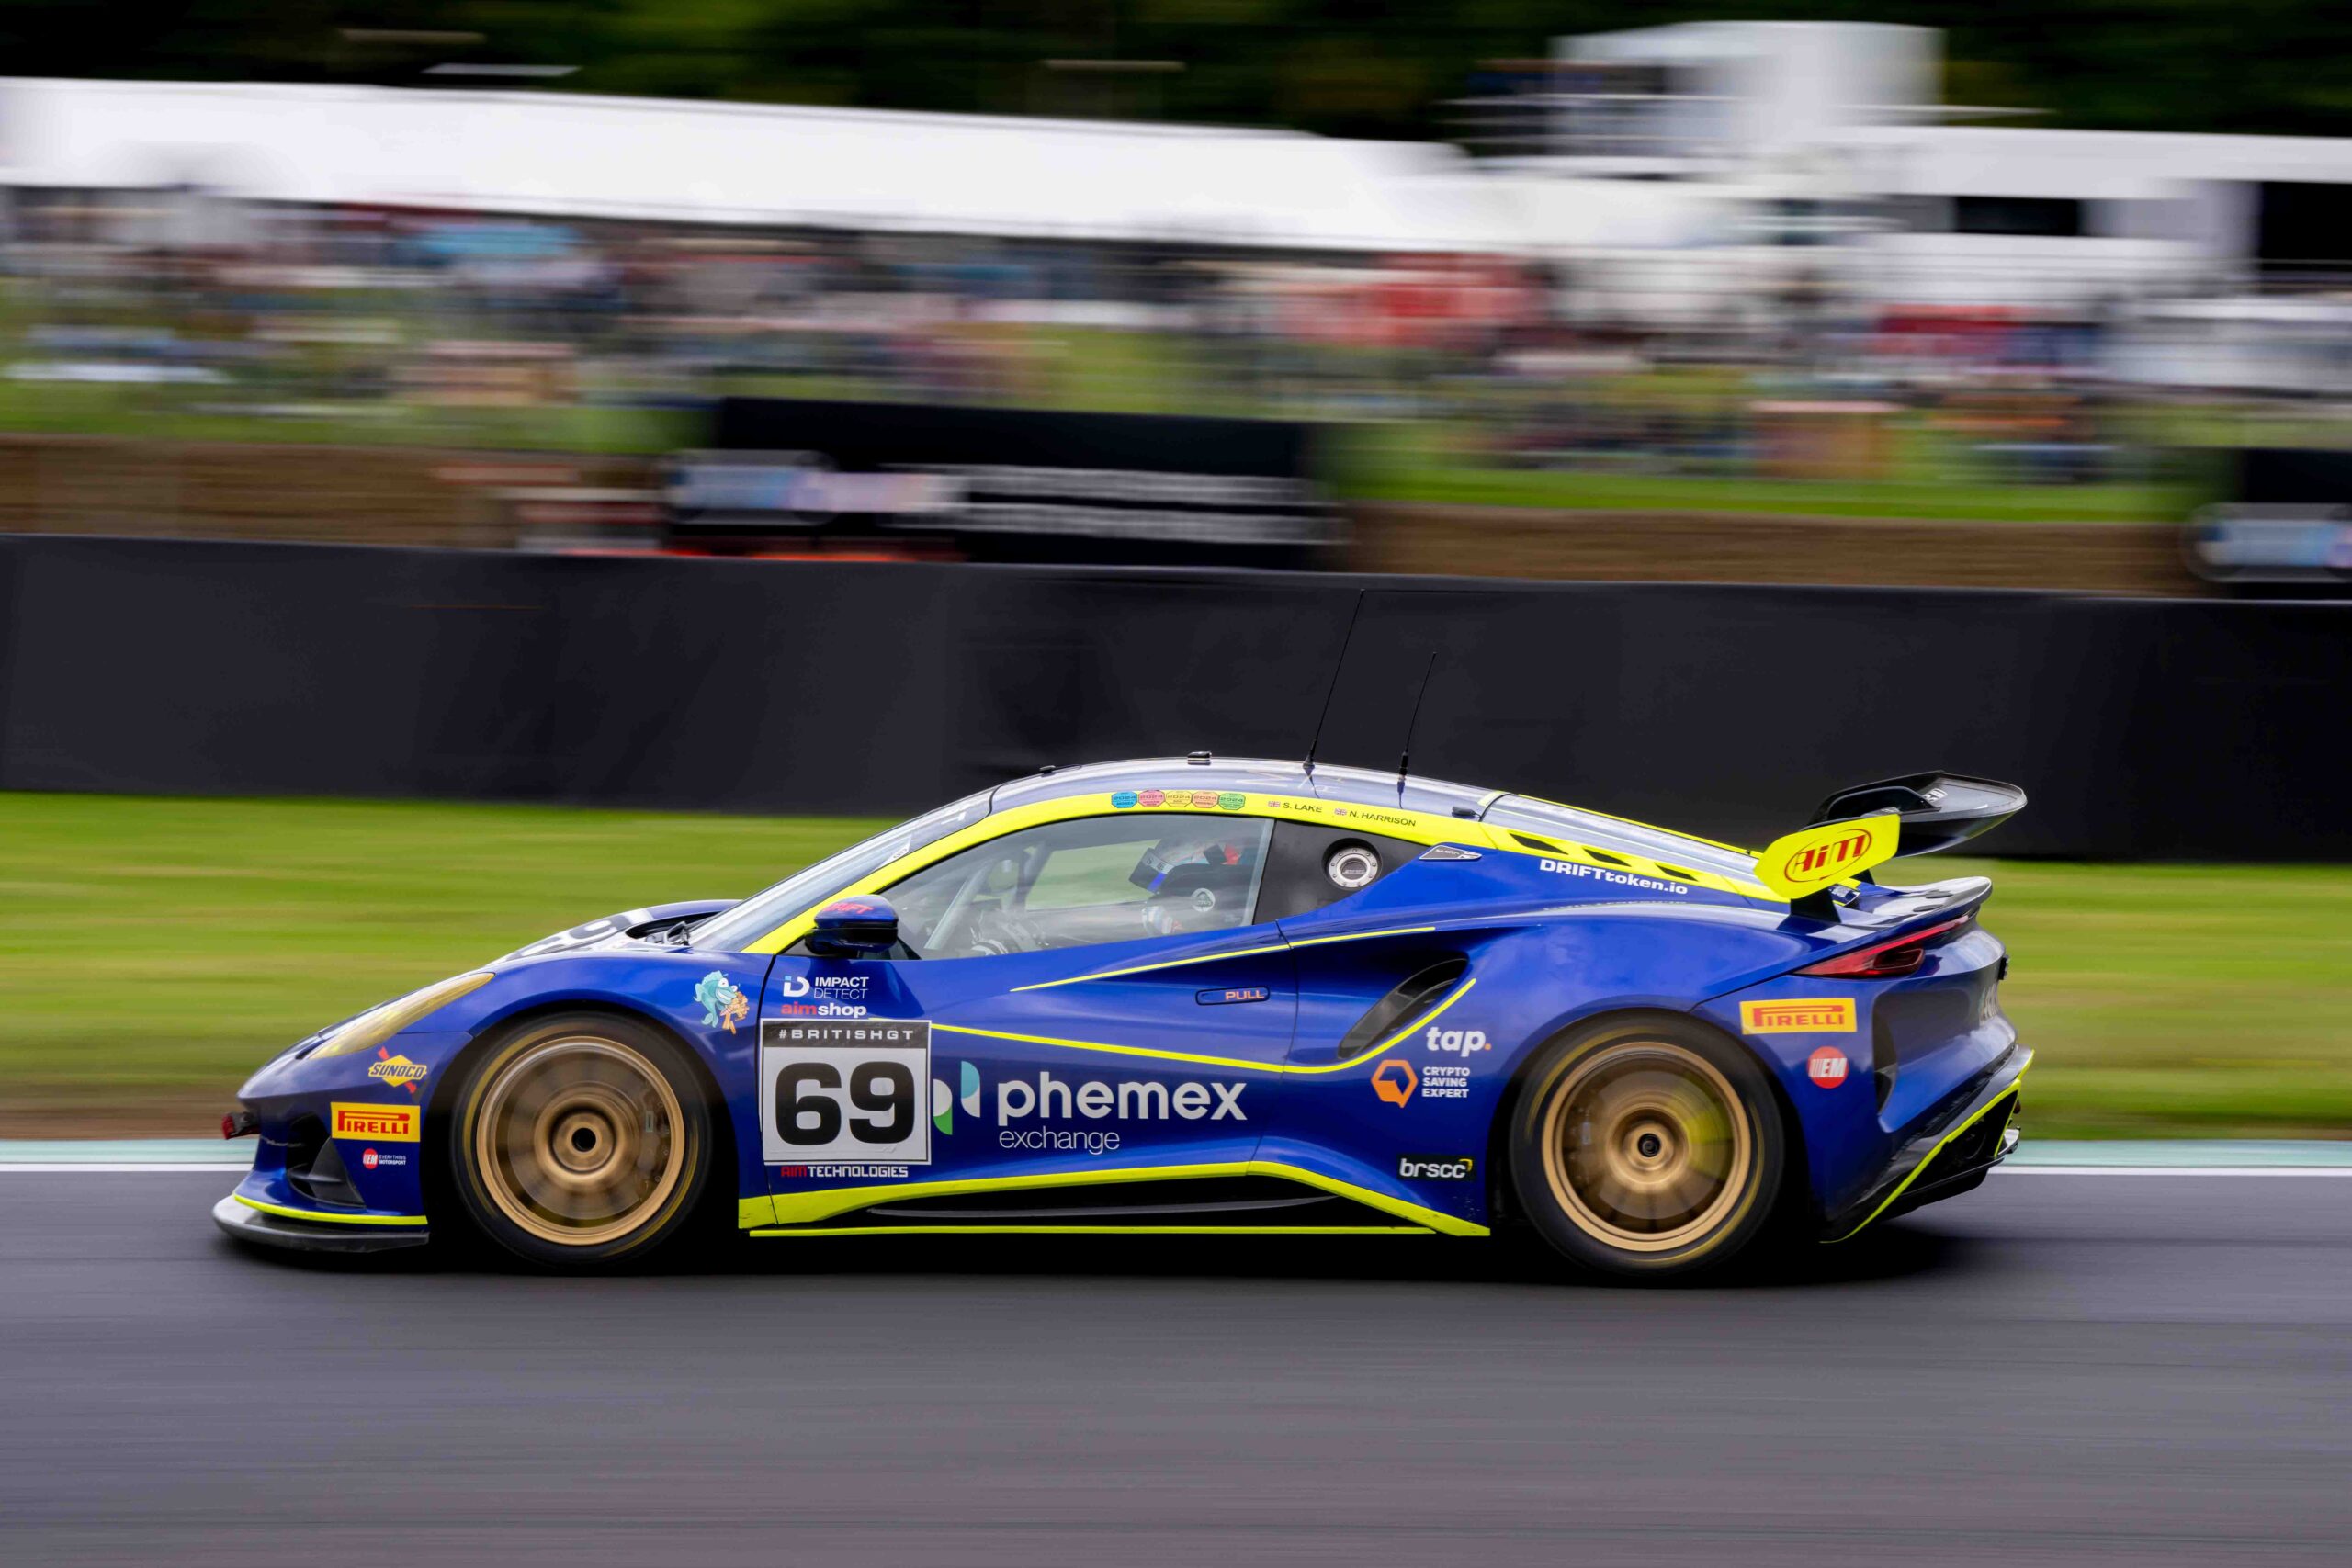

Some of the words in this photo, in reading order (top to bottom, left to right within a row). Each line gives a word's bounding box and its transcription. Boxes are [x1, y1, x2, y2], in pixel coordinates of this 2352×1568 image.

[1295, 804, 1323, 813] LAKE
[1349, 810, 1359, 818] N.
[1361, 812, 1416, 827] HARRISON
[1539, 859, 1688, 895] DRIFTtoken.io
[815, 976, 869, 987] IMPACT
[813, 987, 868, 999] DETECT
[1225, 990, 1265, 1000] PULL
[781, 1001, 867, 1019] aimshop
[1753, 1004, 1845, 1027] PIRELLI
[779, 1029, 914, 1040] #BRITISHGT
[1426, 1026, 1492, 1057] tap.
[370, 1064, 424, 1078] SUNOCO
[1422, 1066, 1471, 1077] CRYPTO
[1422, 1077, 1467, 1088] SAVING
[998, 1071, 1248, 1126] phemex
[1421, 1088, 1470, 1098] EXPERT
[775, 1061, 915, 1145] 69
[337, 1110, 411, 1134] PIRELLI
[999, 1126, 1120, 1155] exchange
[1399, 1157, 1467, 1179] brscc
